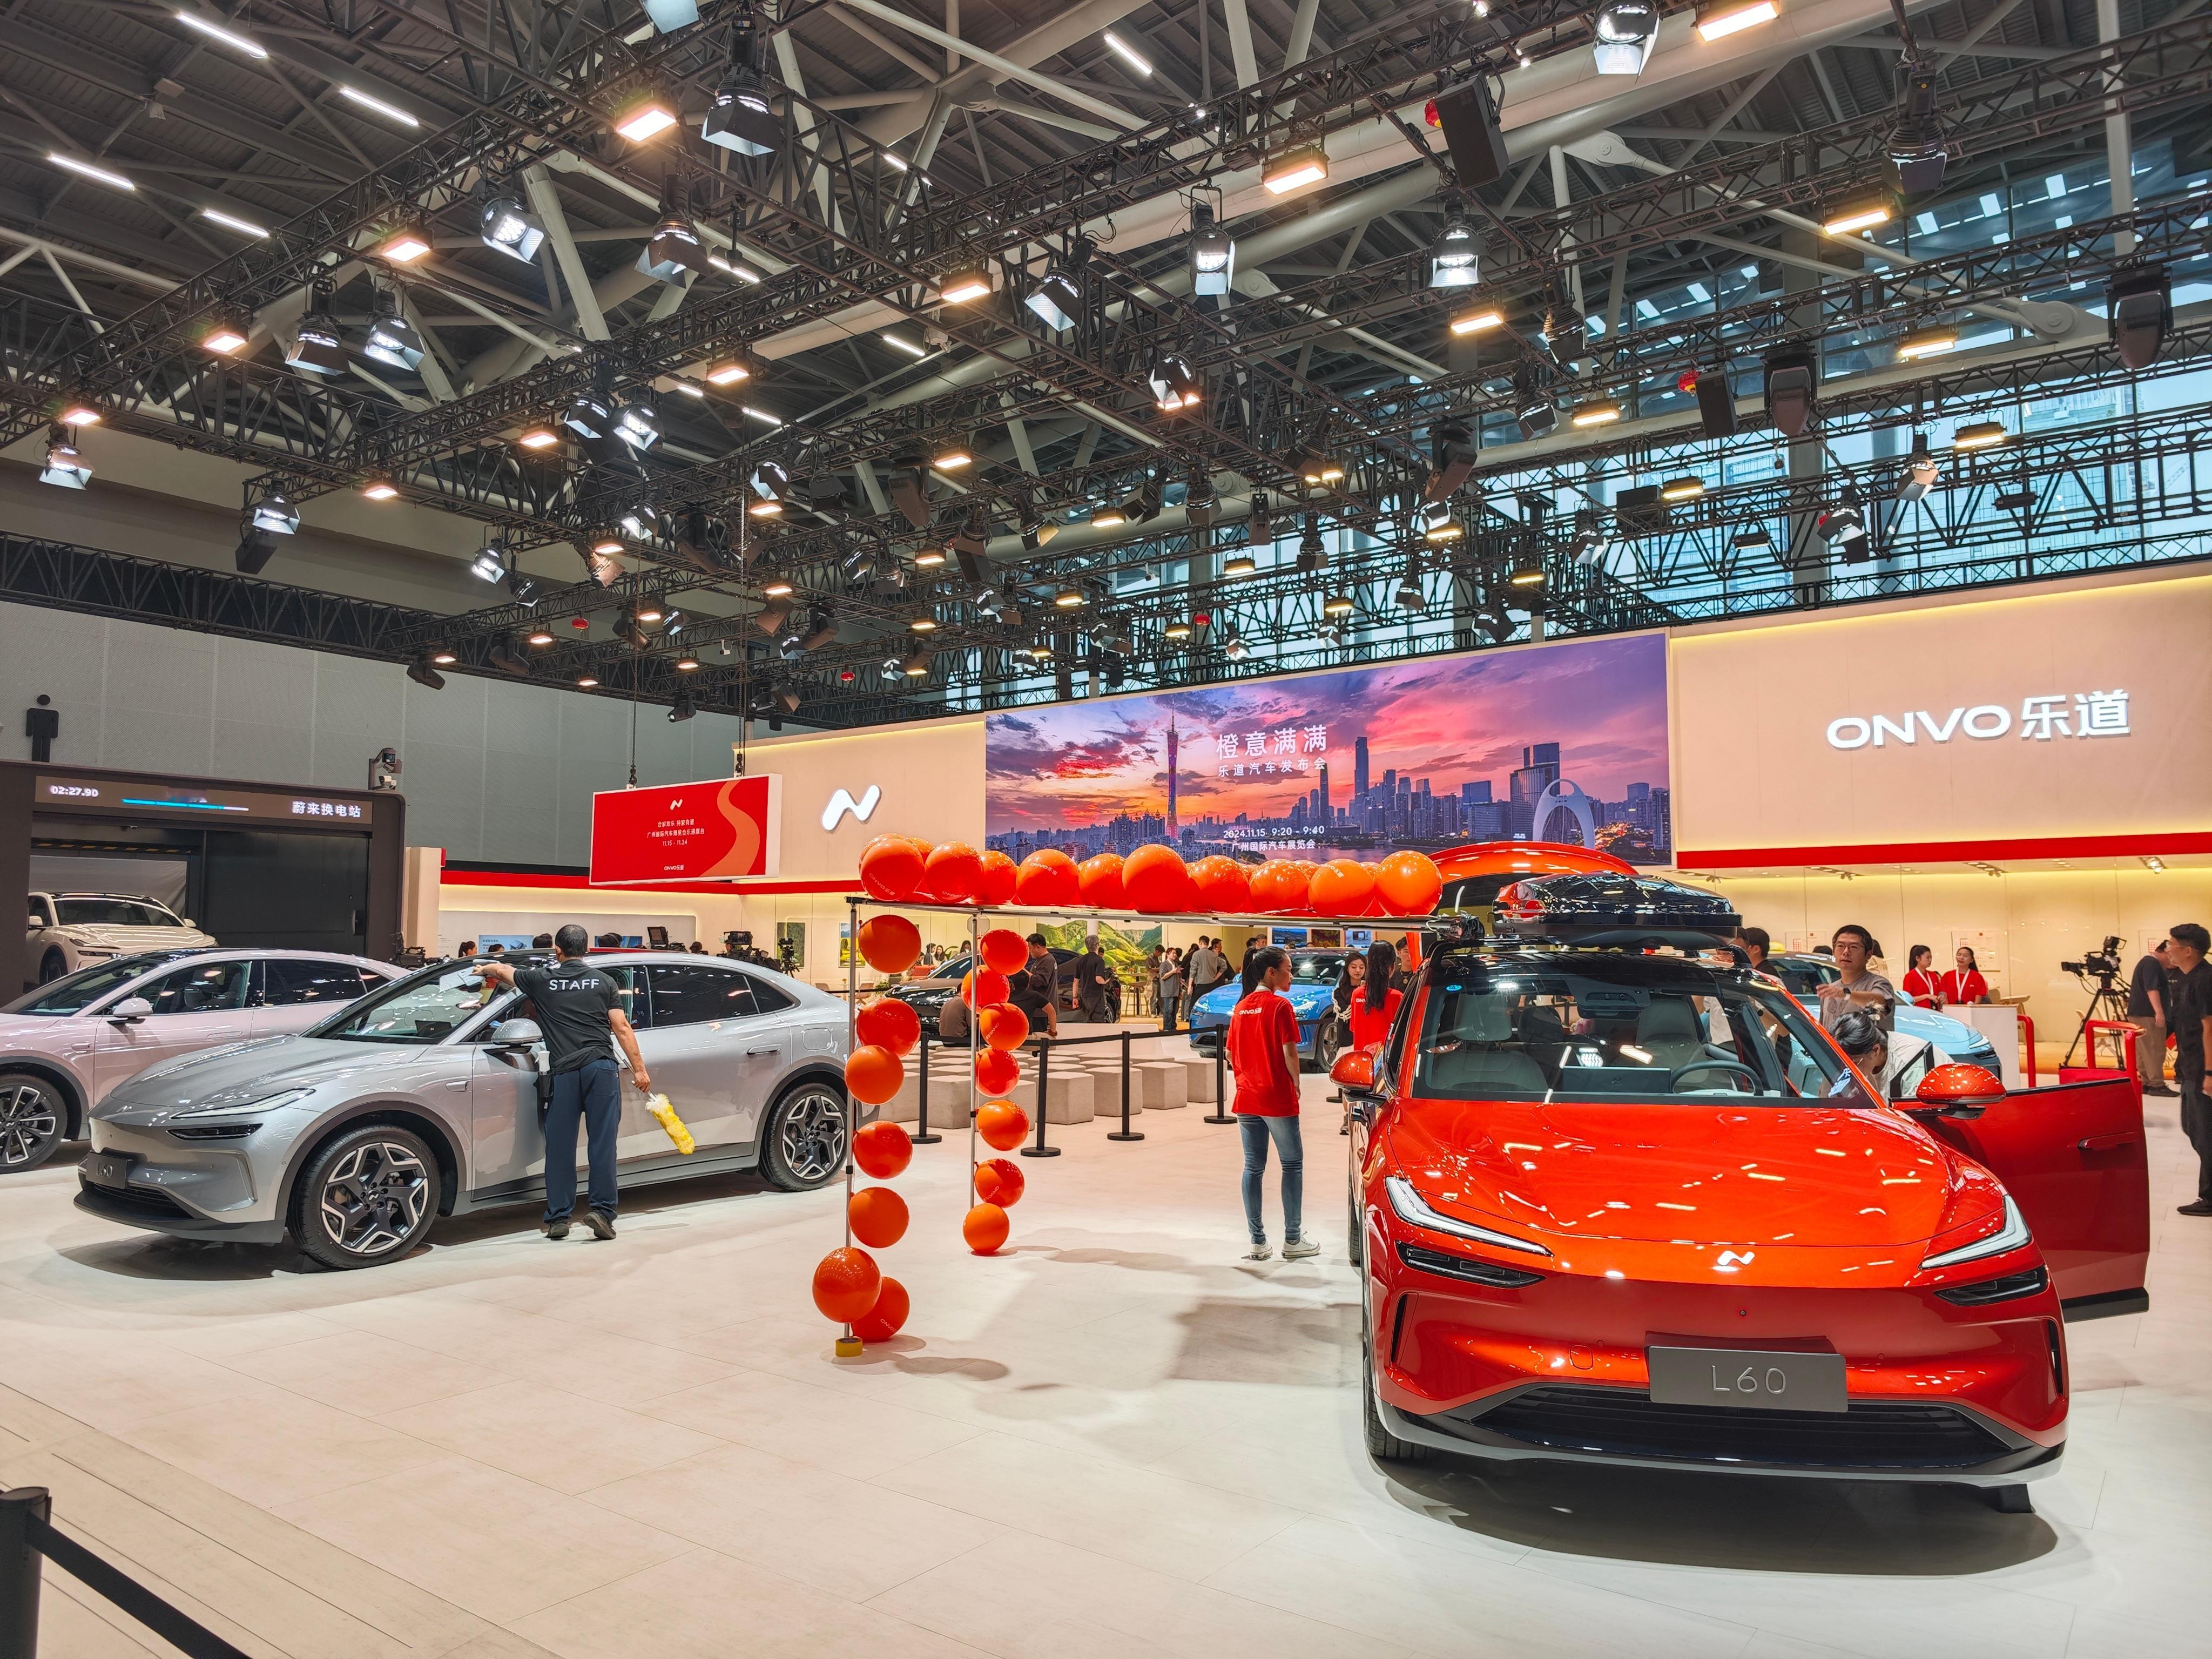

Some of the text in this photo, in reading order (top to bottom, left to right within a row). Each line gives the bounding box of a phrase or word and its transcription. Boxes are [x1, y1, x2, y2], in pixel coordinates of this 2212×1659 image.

[1826, 704, 2012, 749] ONVO
[1216, 724, 1326, 760] 橙意满满
[1218, 757, 1326, 777] 乐道汽车发布会
[50, 785, 99, 797] 02:27.90
[292, 801, 361, 818] 蔚来换电站
[1223, 828, 1265, 838] 2024.11.15
[1271, 827, 1292, 836] 9:20
[1303, 825, 1325, 834] 9:40
[1231, 839, 1316, 852] 广州国际汽车展览会
[549, 979, 599, 990] STAFF
[96, 1162, 113, 1178] L60
[1711, 1365, 1786, 1394] L60
